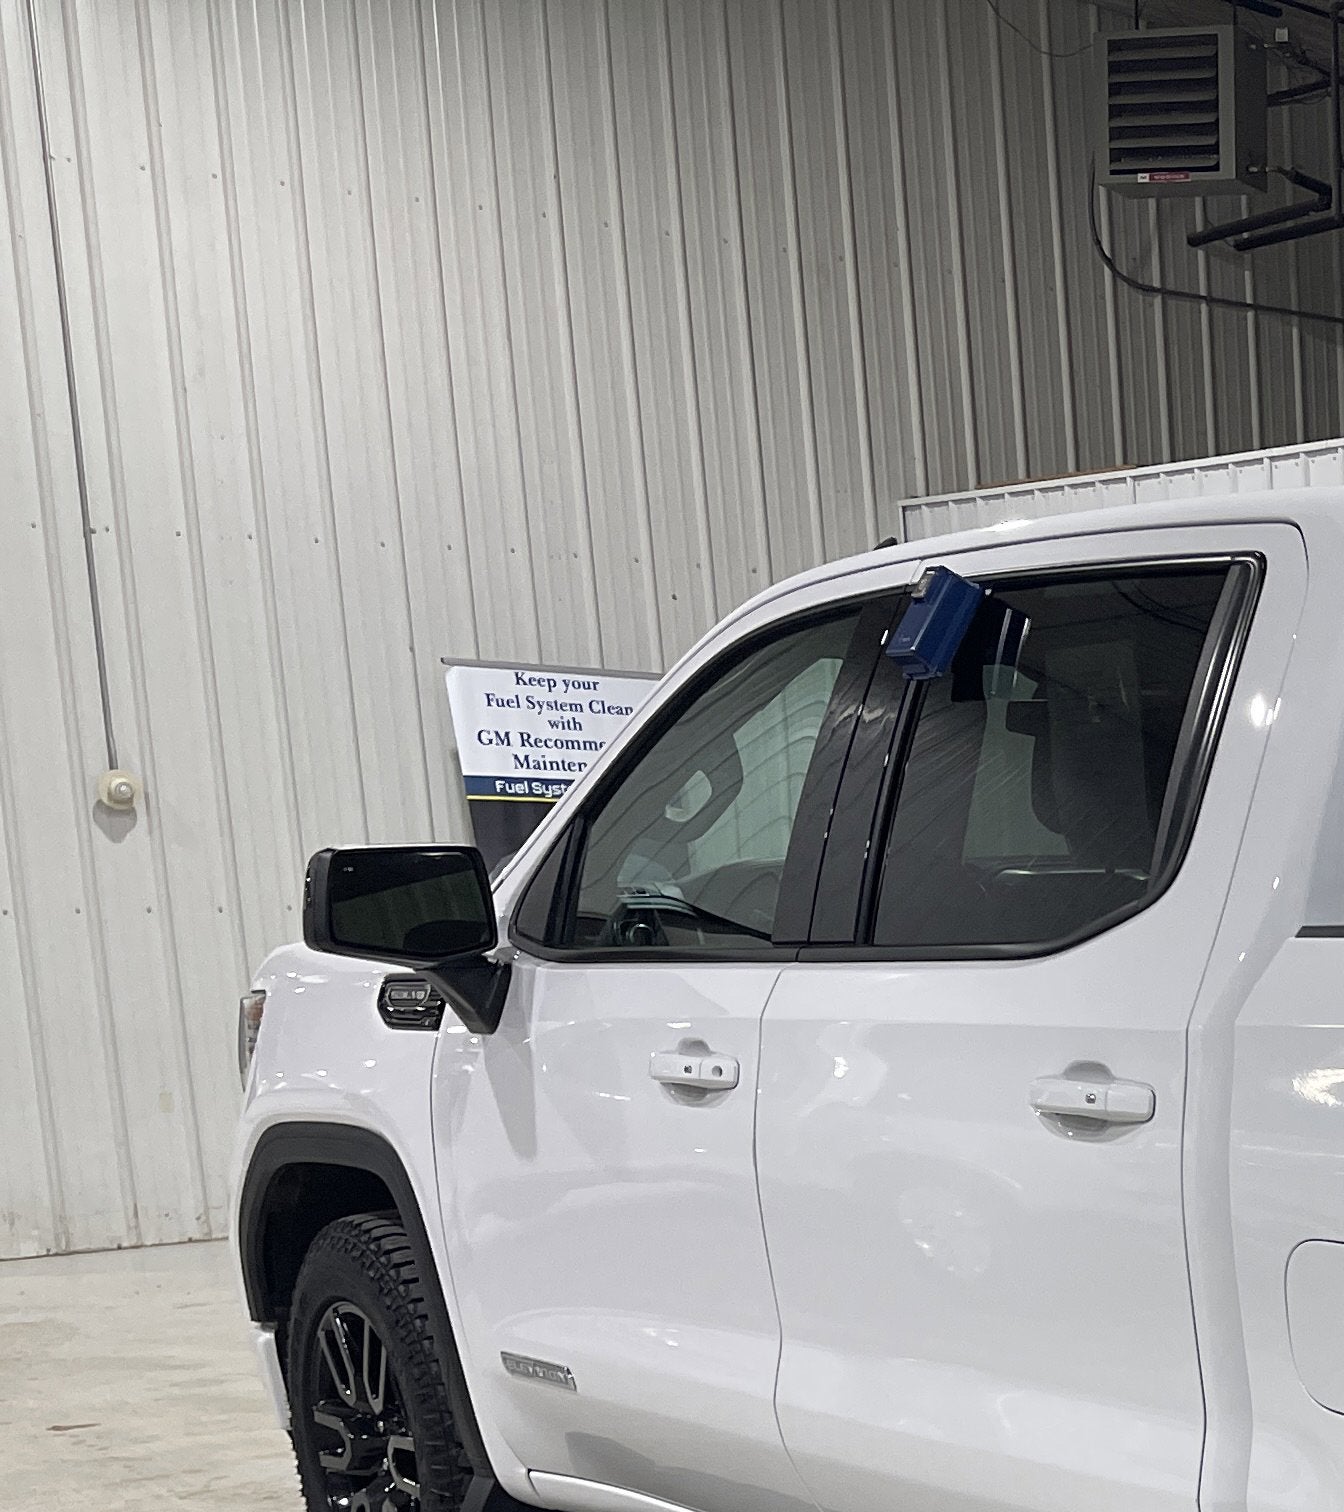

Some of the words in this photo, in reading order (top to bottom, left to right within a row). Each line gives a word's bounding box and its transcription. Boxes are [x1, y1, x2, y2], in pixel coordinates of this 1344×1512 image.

[514, 672, 557, 692] Keep
[562, 679, 600, 694] your
[484, 692, 522, 710] Fuel
[526, 695, 584, 716] System
[548, 716, 583, 732] with
[477, 729, 511, 747] GM
[495, 780, 528, 794] Fuel
